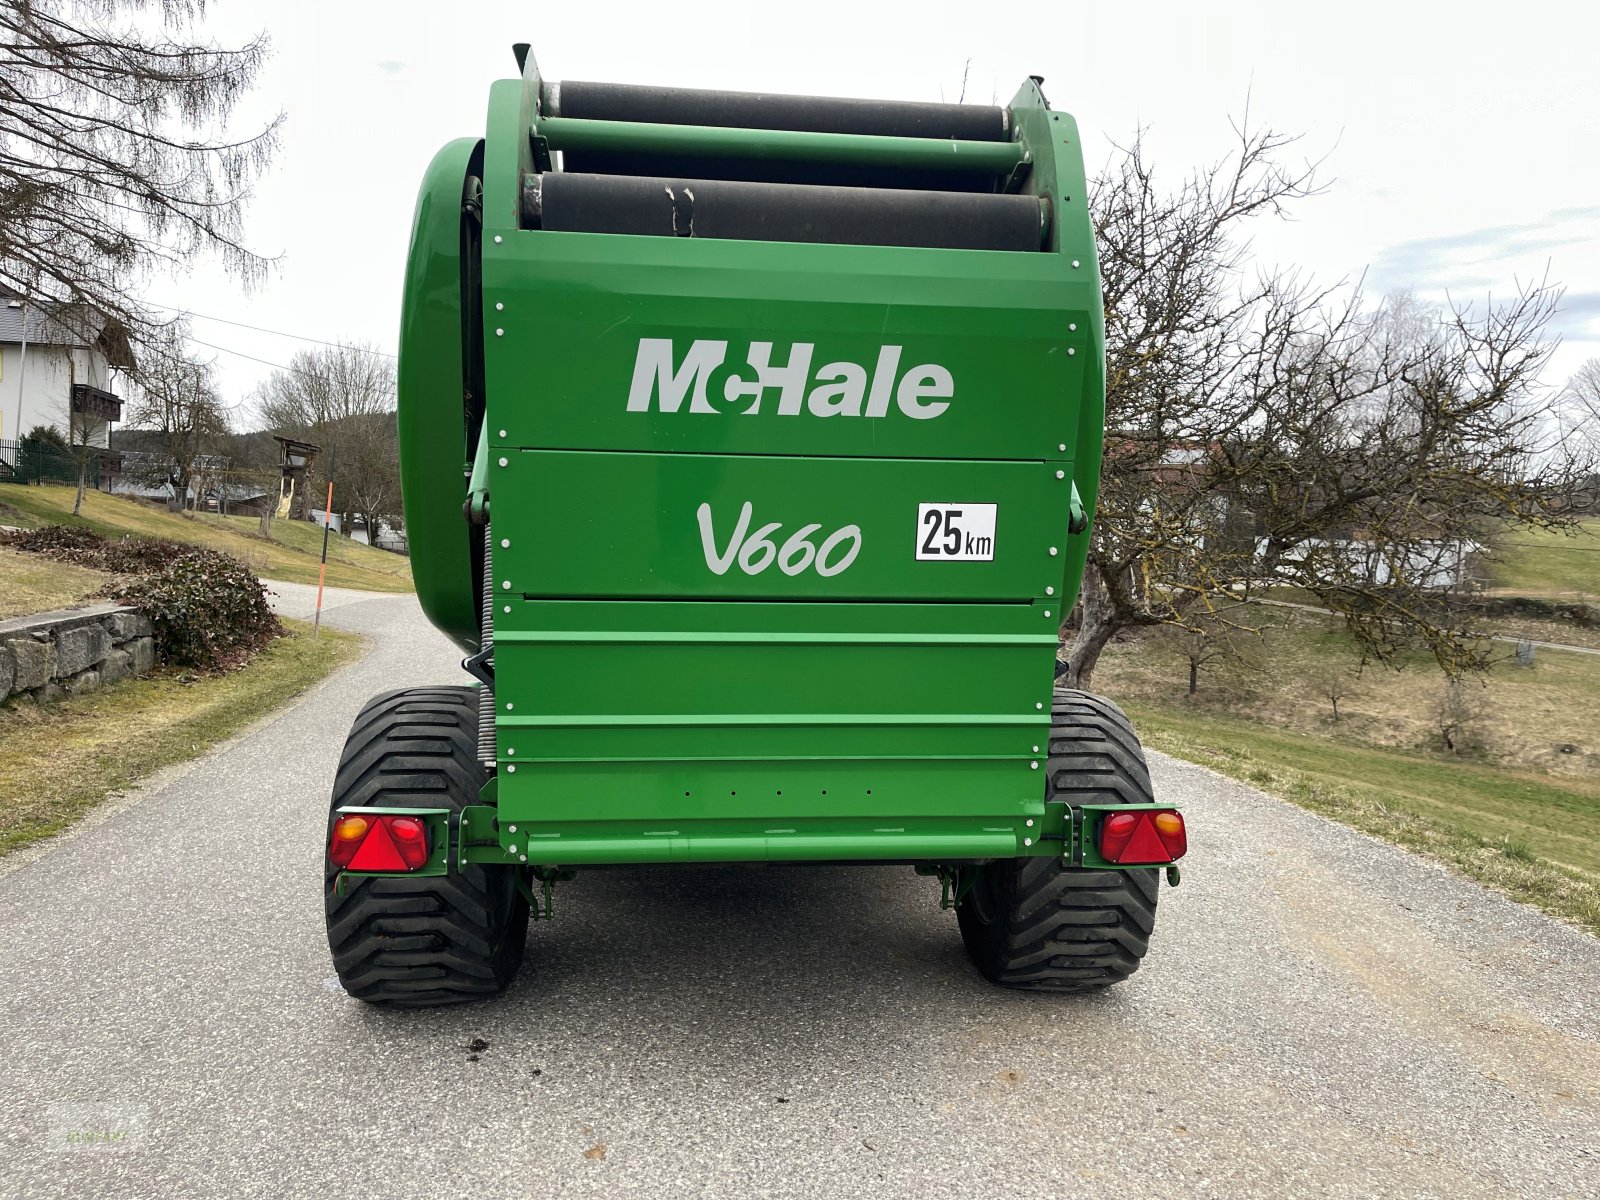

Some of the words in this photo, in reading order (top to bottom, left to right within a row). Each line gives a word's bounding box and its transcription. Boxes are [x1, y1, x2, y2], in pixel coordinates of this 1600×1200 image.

[626, 337, 954, 420] McHale
[696, 501, 862, 577] V660
[921, 509, 963, 556] 25
[964, 531, 991, 555] km
